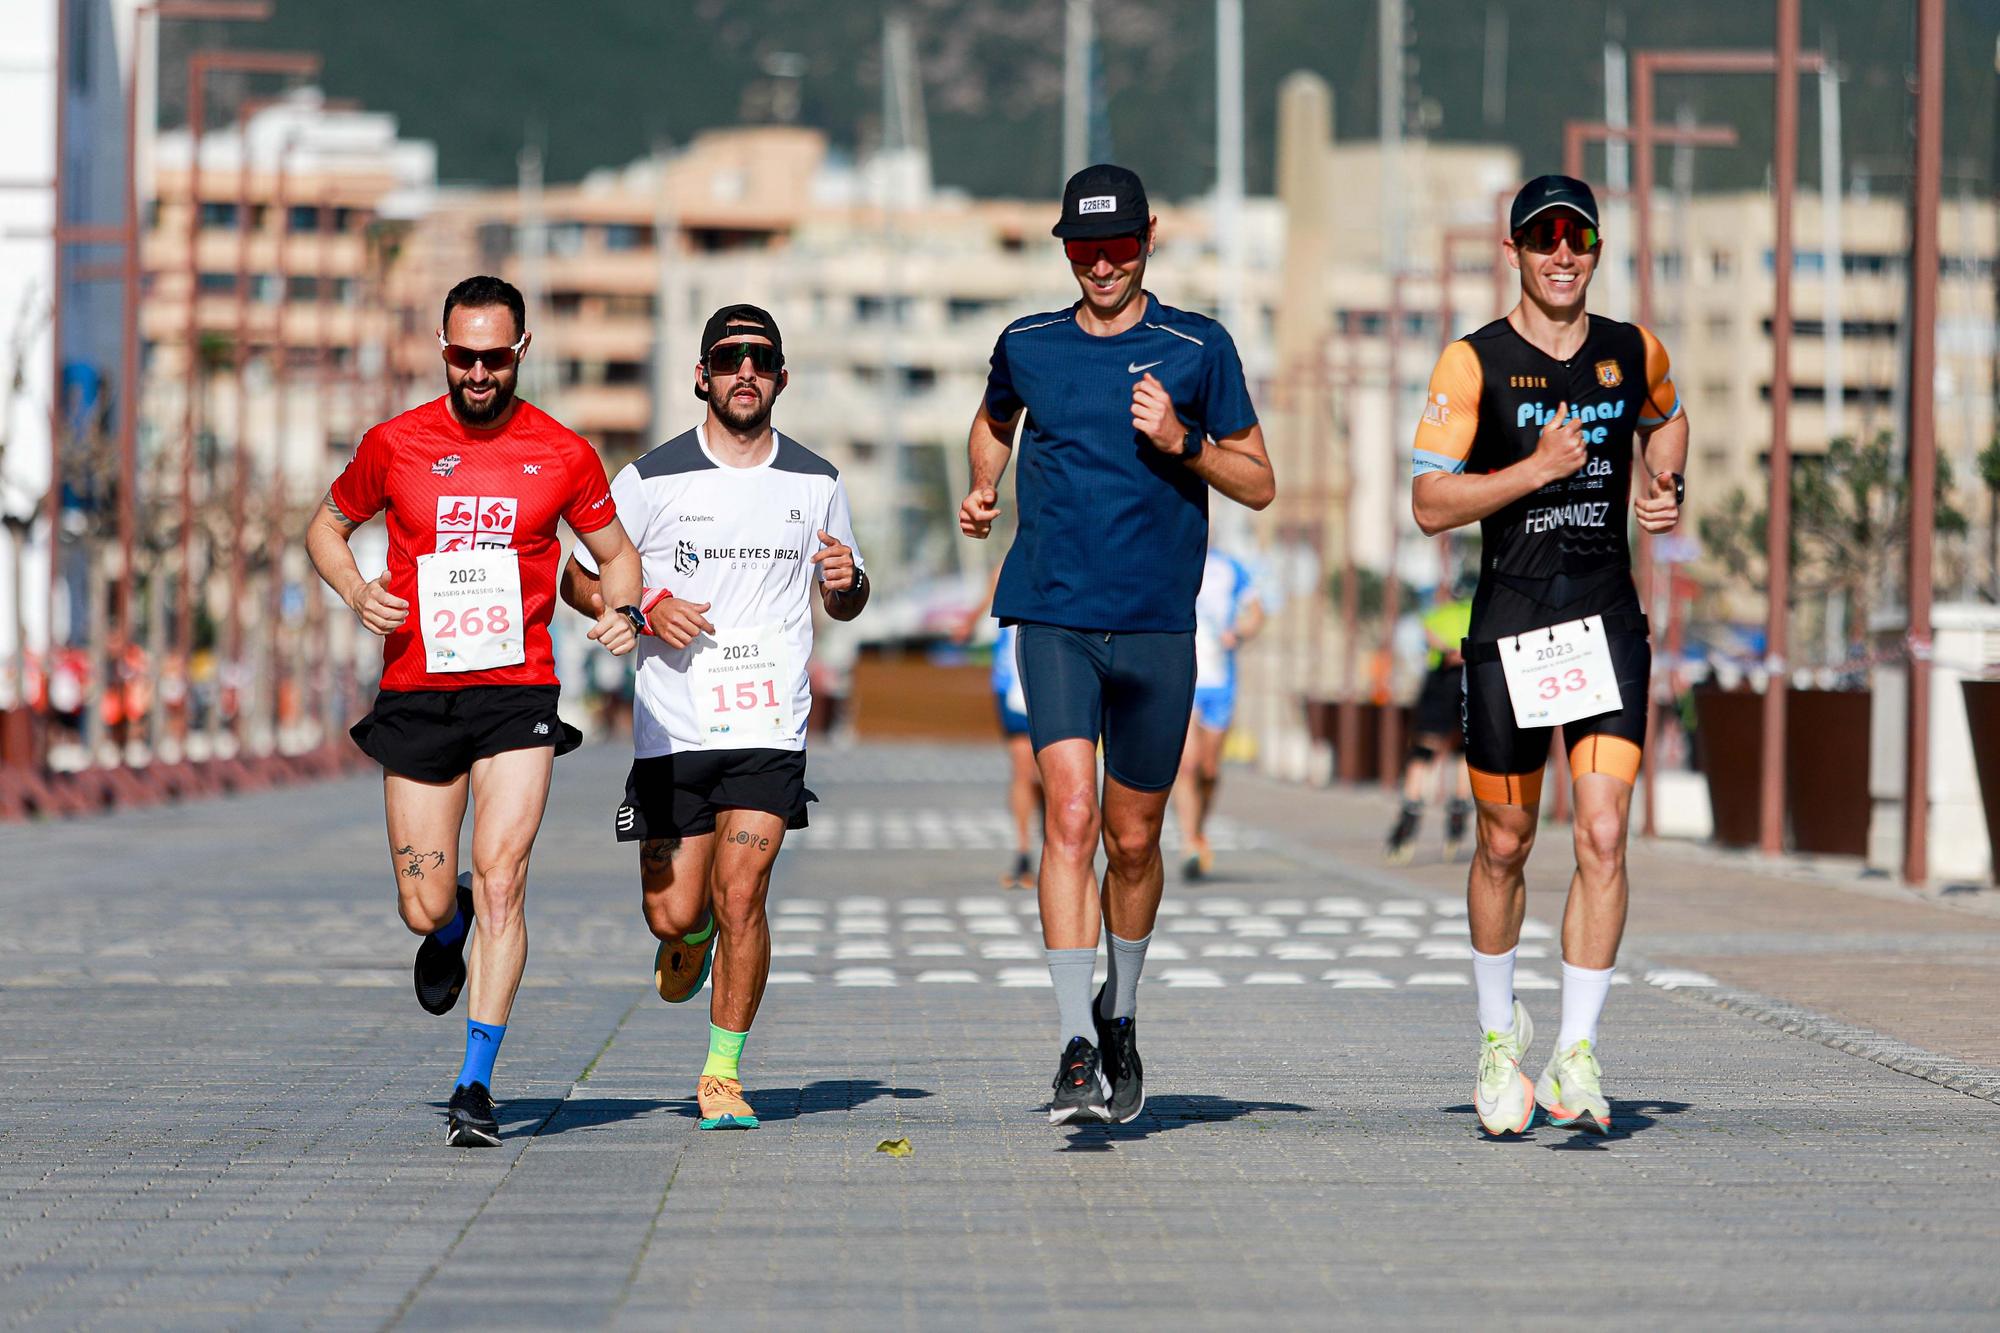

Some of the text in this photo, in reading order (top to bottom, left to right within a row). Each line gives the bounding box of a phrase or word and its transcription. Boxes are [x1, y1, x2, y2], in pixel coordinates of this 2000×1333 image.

[704, 549, 799, 560] BLUE EYES IBIZA
[731, 562, 776, 570] GROUP
[449, 568, 486, 584] 2023
[433, 605, 510, 639] 268
[723, 644, 759, 660] 2023
[1536, 643, 1574, 661] 2023
[1538, 668, 1587, 700] 33
[712, 680, 780, 713] 151
